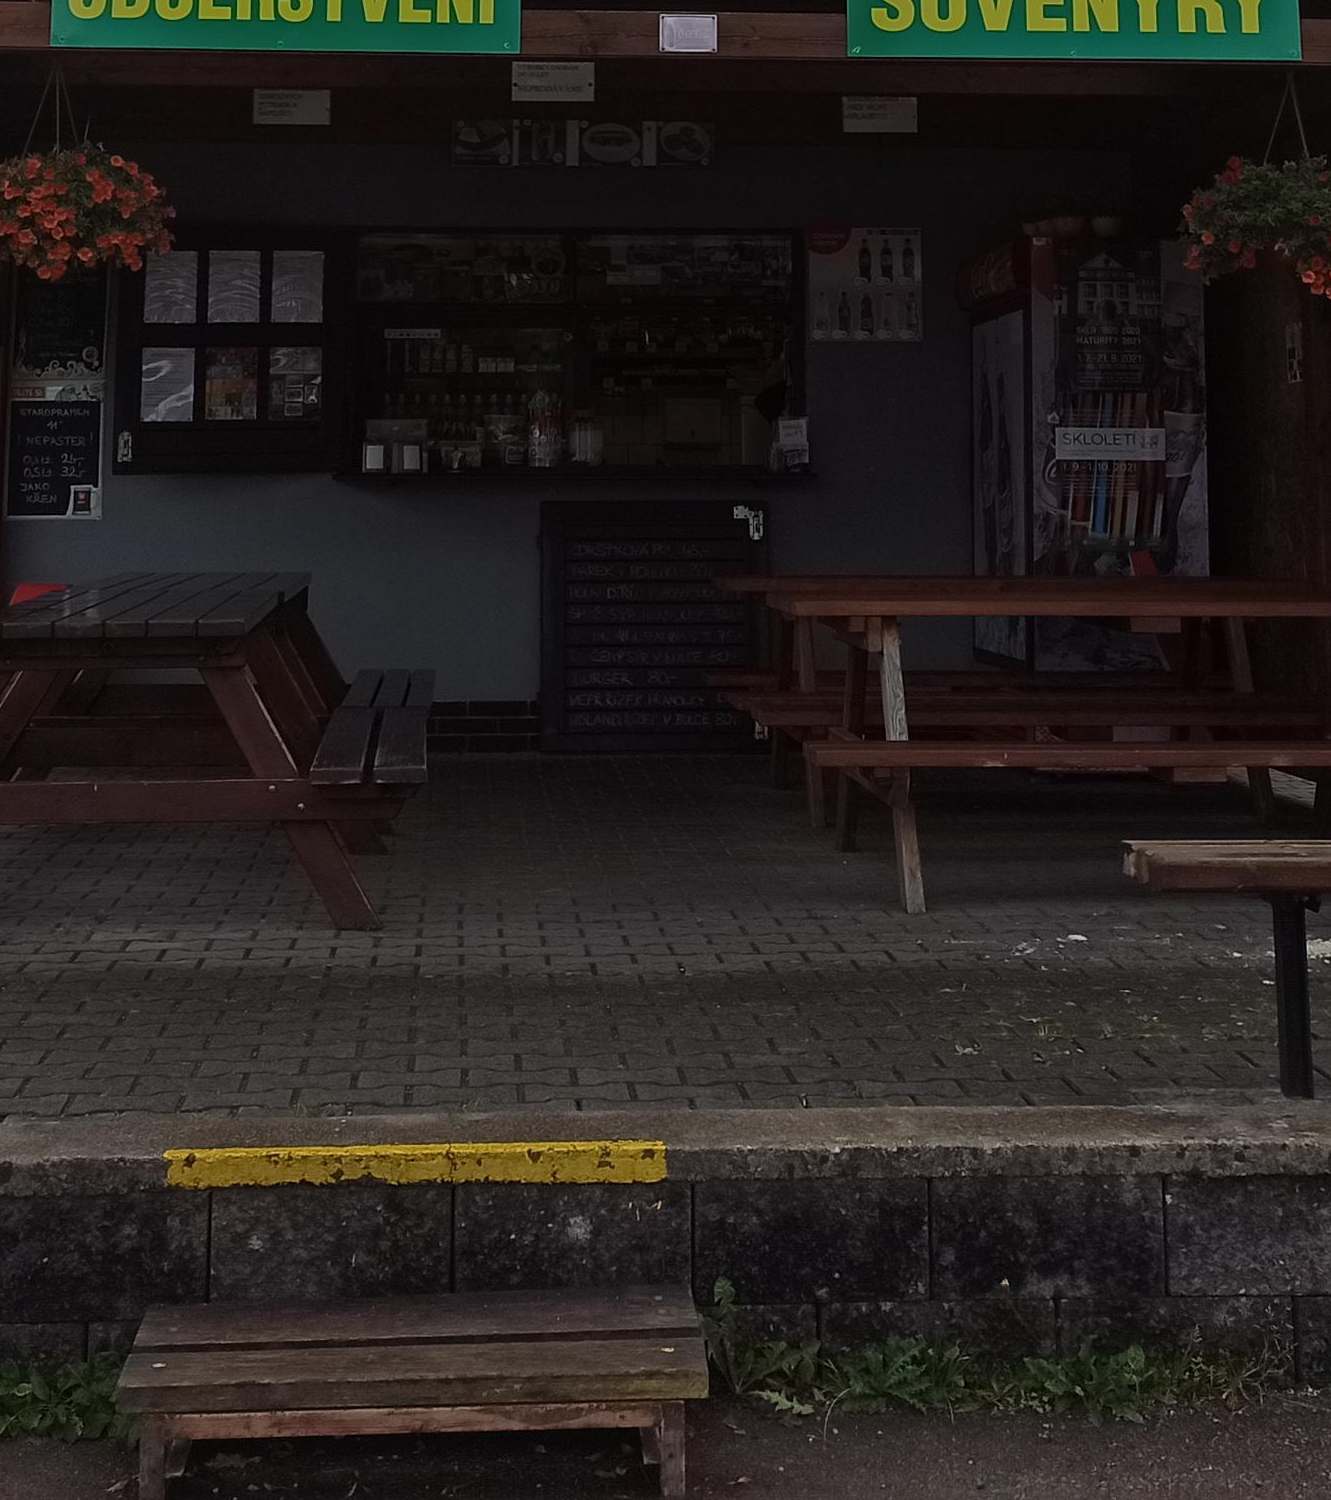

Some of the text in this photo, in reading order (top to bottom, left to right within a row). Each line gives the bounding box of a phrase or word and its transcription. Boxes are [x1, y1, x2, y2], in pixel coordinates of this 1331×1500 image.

[19, 408, 90, 418] STAROPRAMEN
[26, 435, 86, 447] NEPASTER
[1062, 431, 1136, 446] SKLOLETÍ
[19, 482, 51, 493] JAKO
